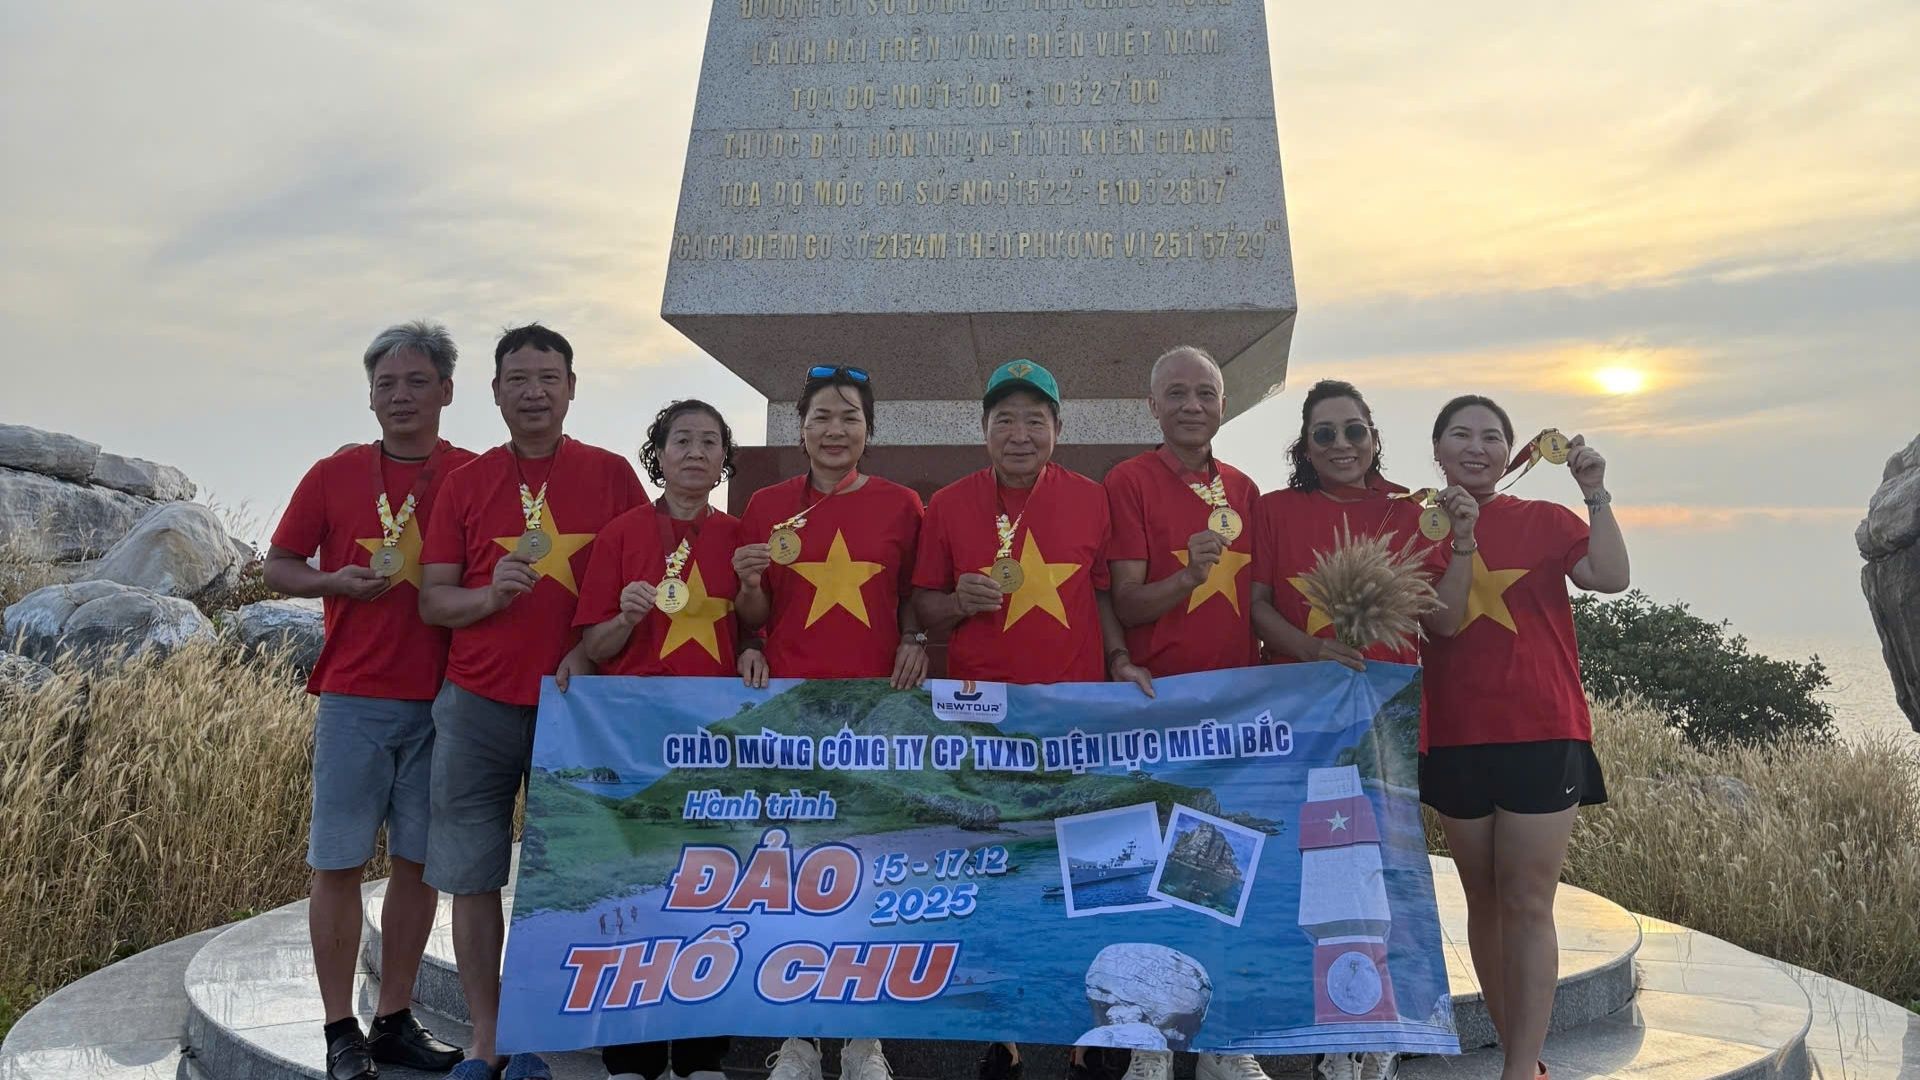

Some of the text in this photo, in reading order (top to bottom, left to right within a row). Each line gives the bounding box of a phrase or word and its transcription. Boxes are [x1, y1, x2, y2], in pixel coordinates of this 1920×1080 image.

[879, 27, 940, 62] TRÊN
[1027, 16, 1084, 58] BIỂN
[1096, 22, 1151, 63] VIỆT
[1163, 28, 1219, 57] NAM
[1081, 119, 1144, 155] KIÊN
[1155, 127, 1233, 154] GIANG
[874, 232, 947, 260] 2154M
[937, 702, 1000, 712] NEWTOUR
[665, 713, 1291, 773] CHÀO MỪNG CÔNG TY CP TVXD ĐIỆN LỰC MIỀN BẮC
[684, 791, 836, 819] Hành trình
[663, 827, 864, 914] ĐẢO
[873, 852, 909, 885] 15
[935, 845, 1008, 879] 17.12
[870, 882, 979, 925] 2025
[559, 921, 962, 1014] THỔ CHU
